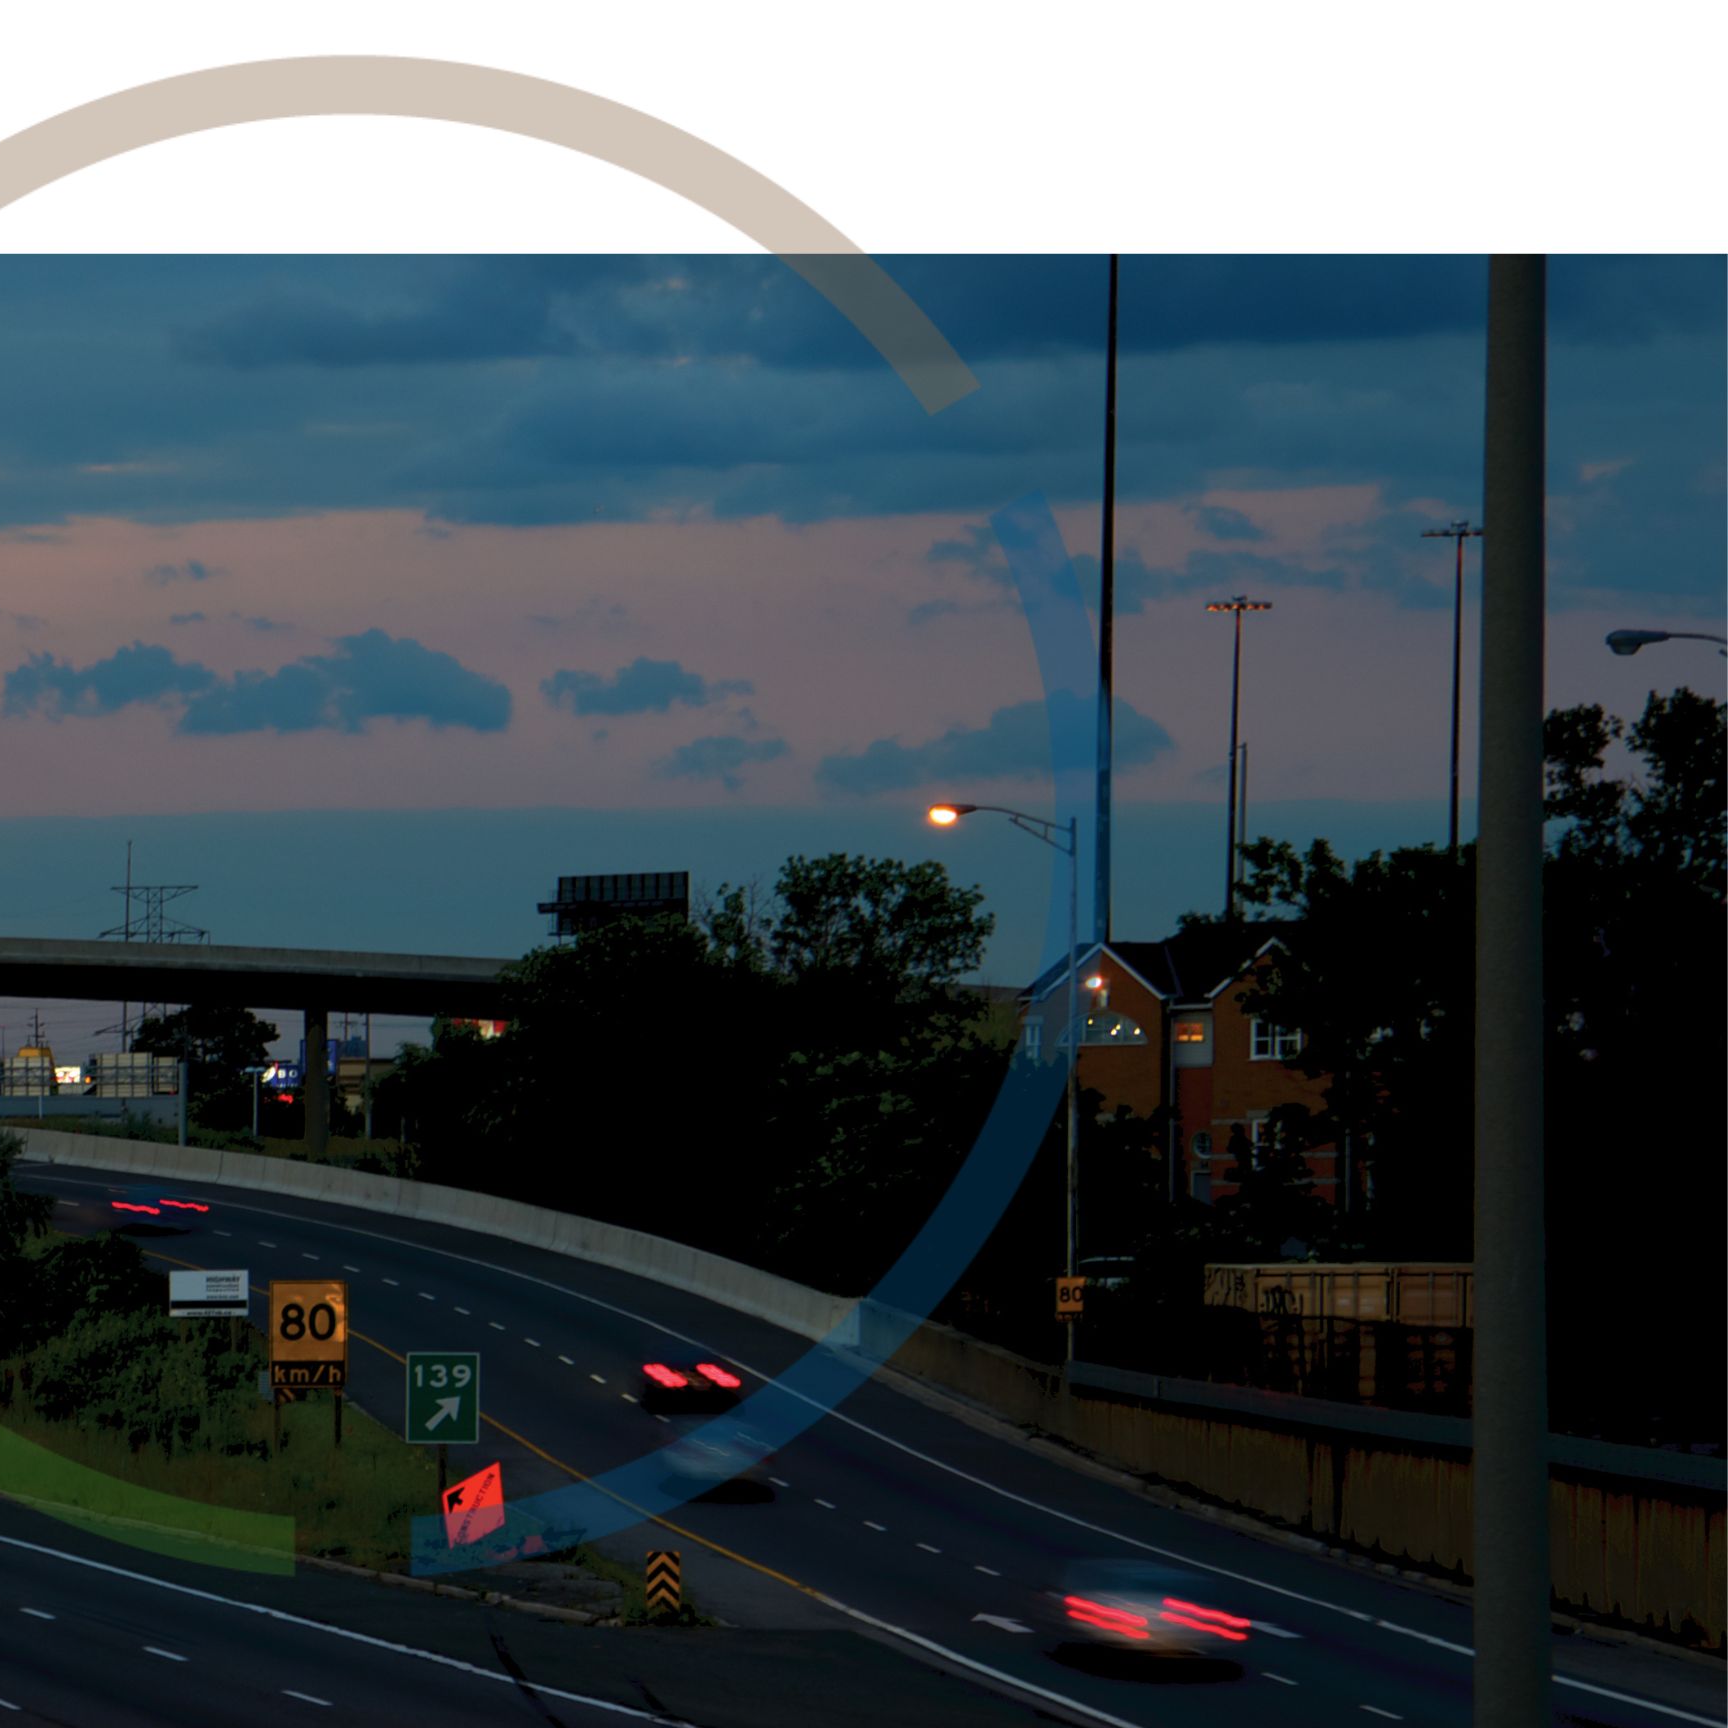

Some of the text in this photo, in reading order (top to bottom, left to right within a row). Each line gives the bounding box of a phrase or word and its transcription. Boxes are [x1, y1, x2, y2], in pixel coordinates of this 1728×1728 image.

[1060, 1287, 1084, 1302] 80
[280, 1303, 336, 1341] 80
[274, 1365, 342, 1383] km/h
[414, 1364, 472, 1388] 139
